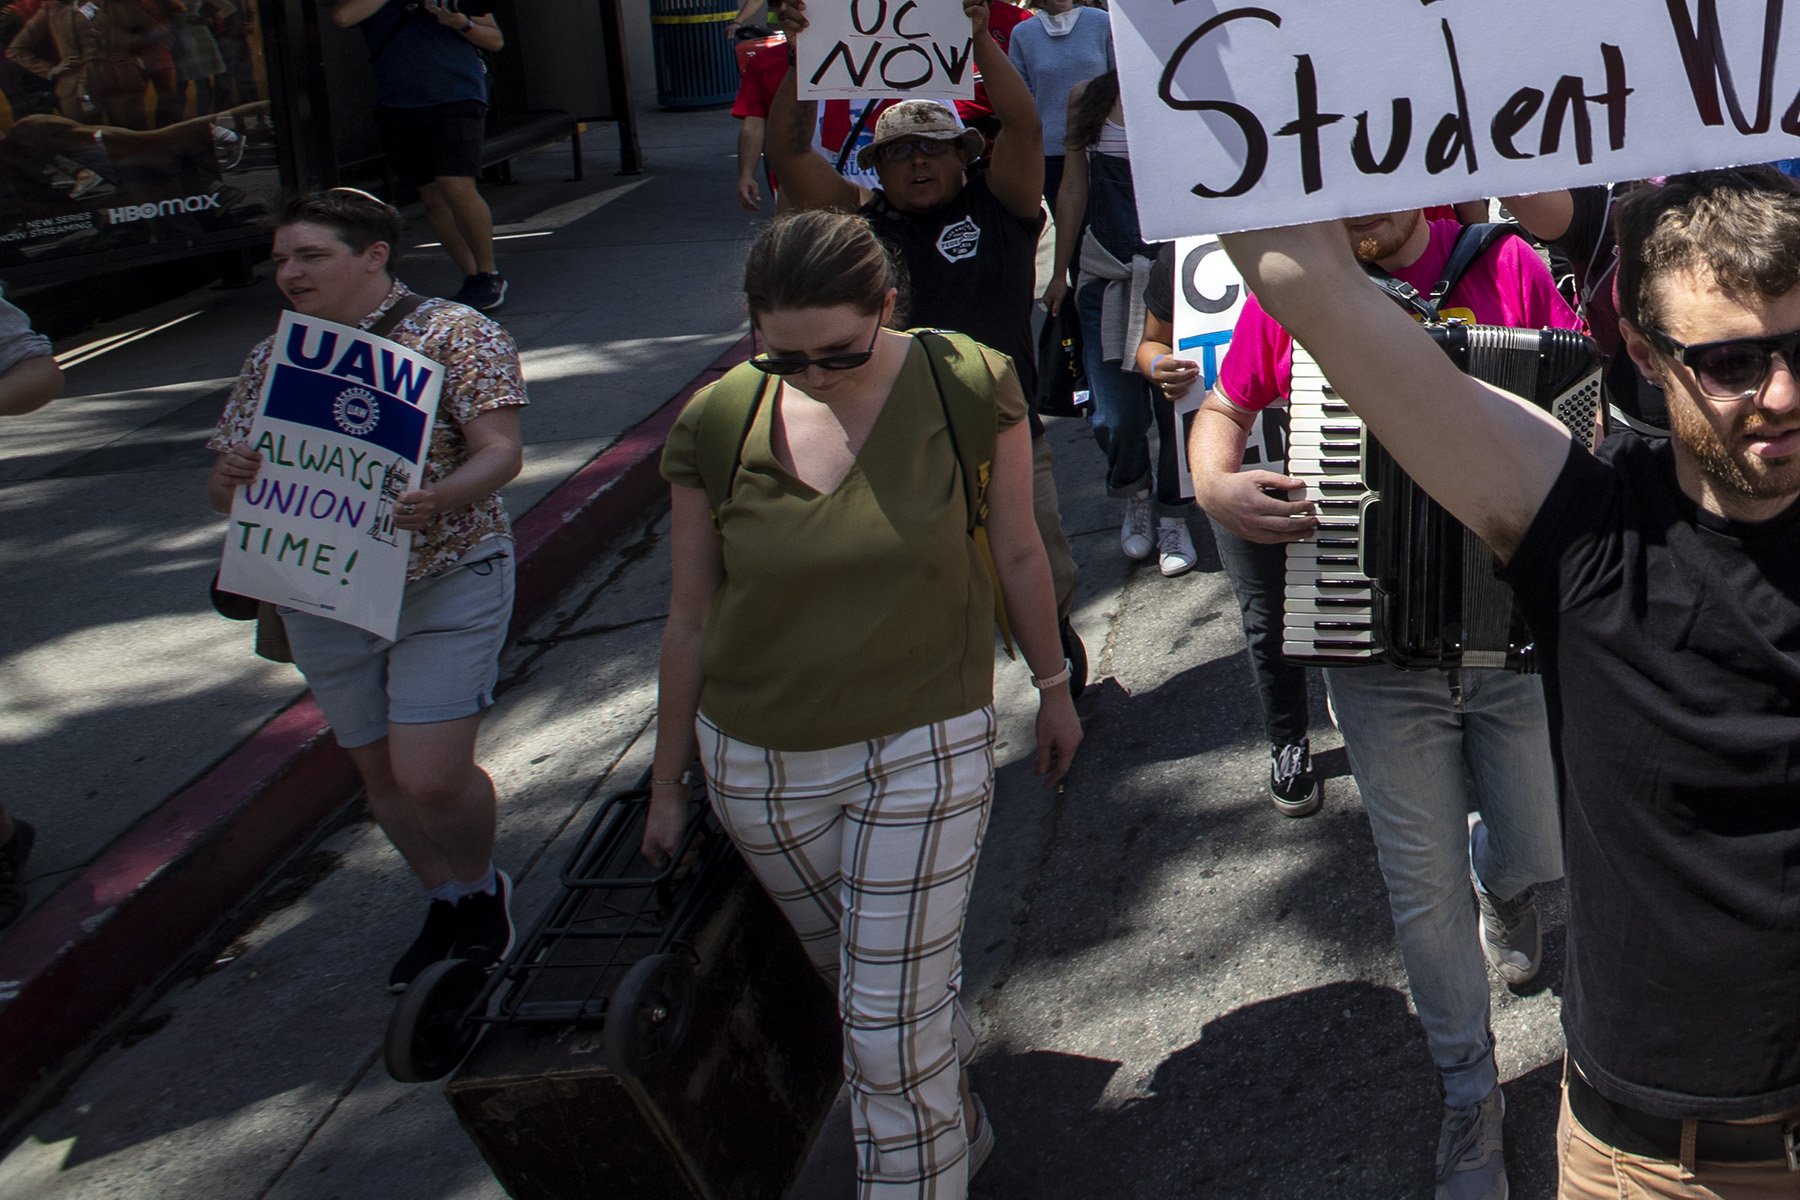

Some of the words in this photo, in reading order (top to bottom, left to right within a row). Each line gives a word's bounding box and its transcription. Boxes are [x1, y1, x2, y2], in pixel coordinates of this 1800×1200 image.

[809, 36, 973, 89] NOW
[1156, 5, 1636, 199] Student
[26, 218, 53, 229] NEW
[56, 211, 91, 224] SERIES
[29, 220, 93, 239] STREAMING
[285, 322, 433, 406] UAW
[346, 402, 369, 418] UAW
[255, 430, 384, 491] ALWAYS
[244, 478, 367, 528] UNION
[236, 520, 359, 586] TIME!
